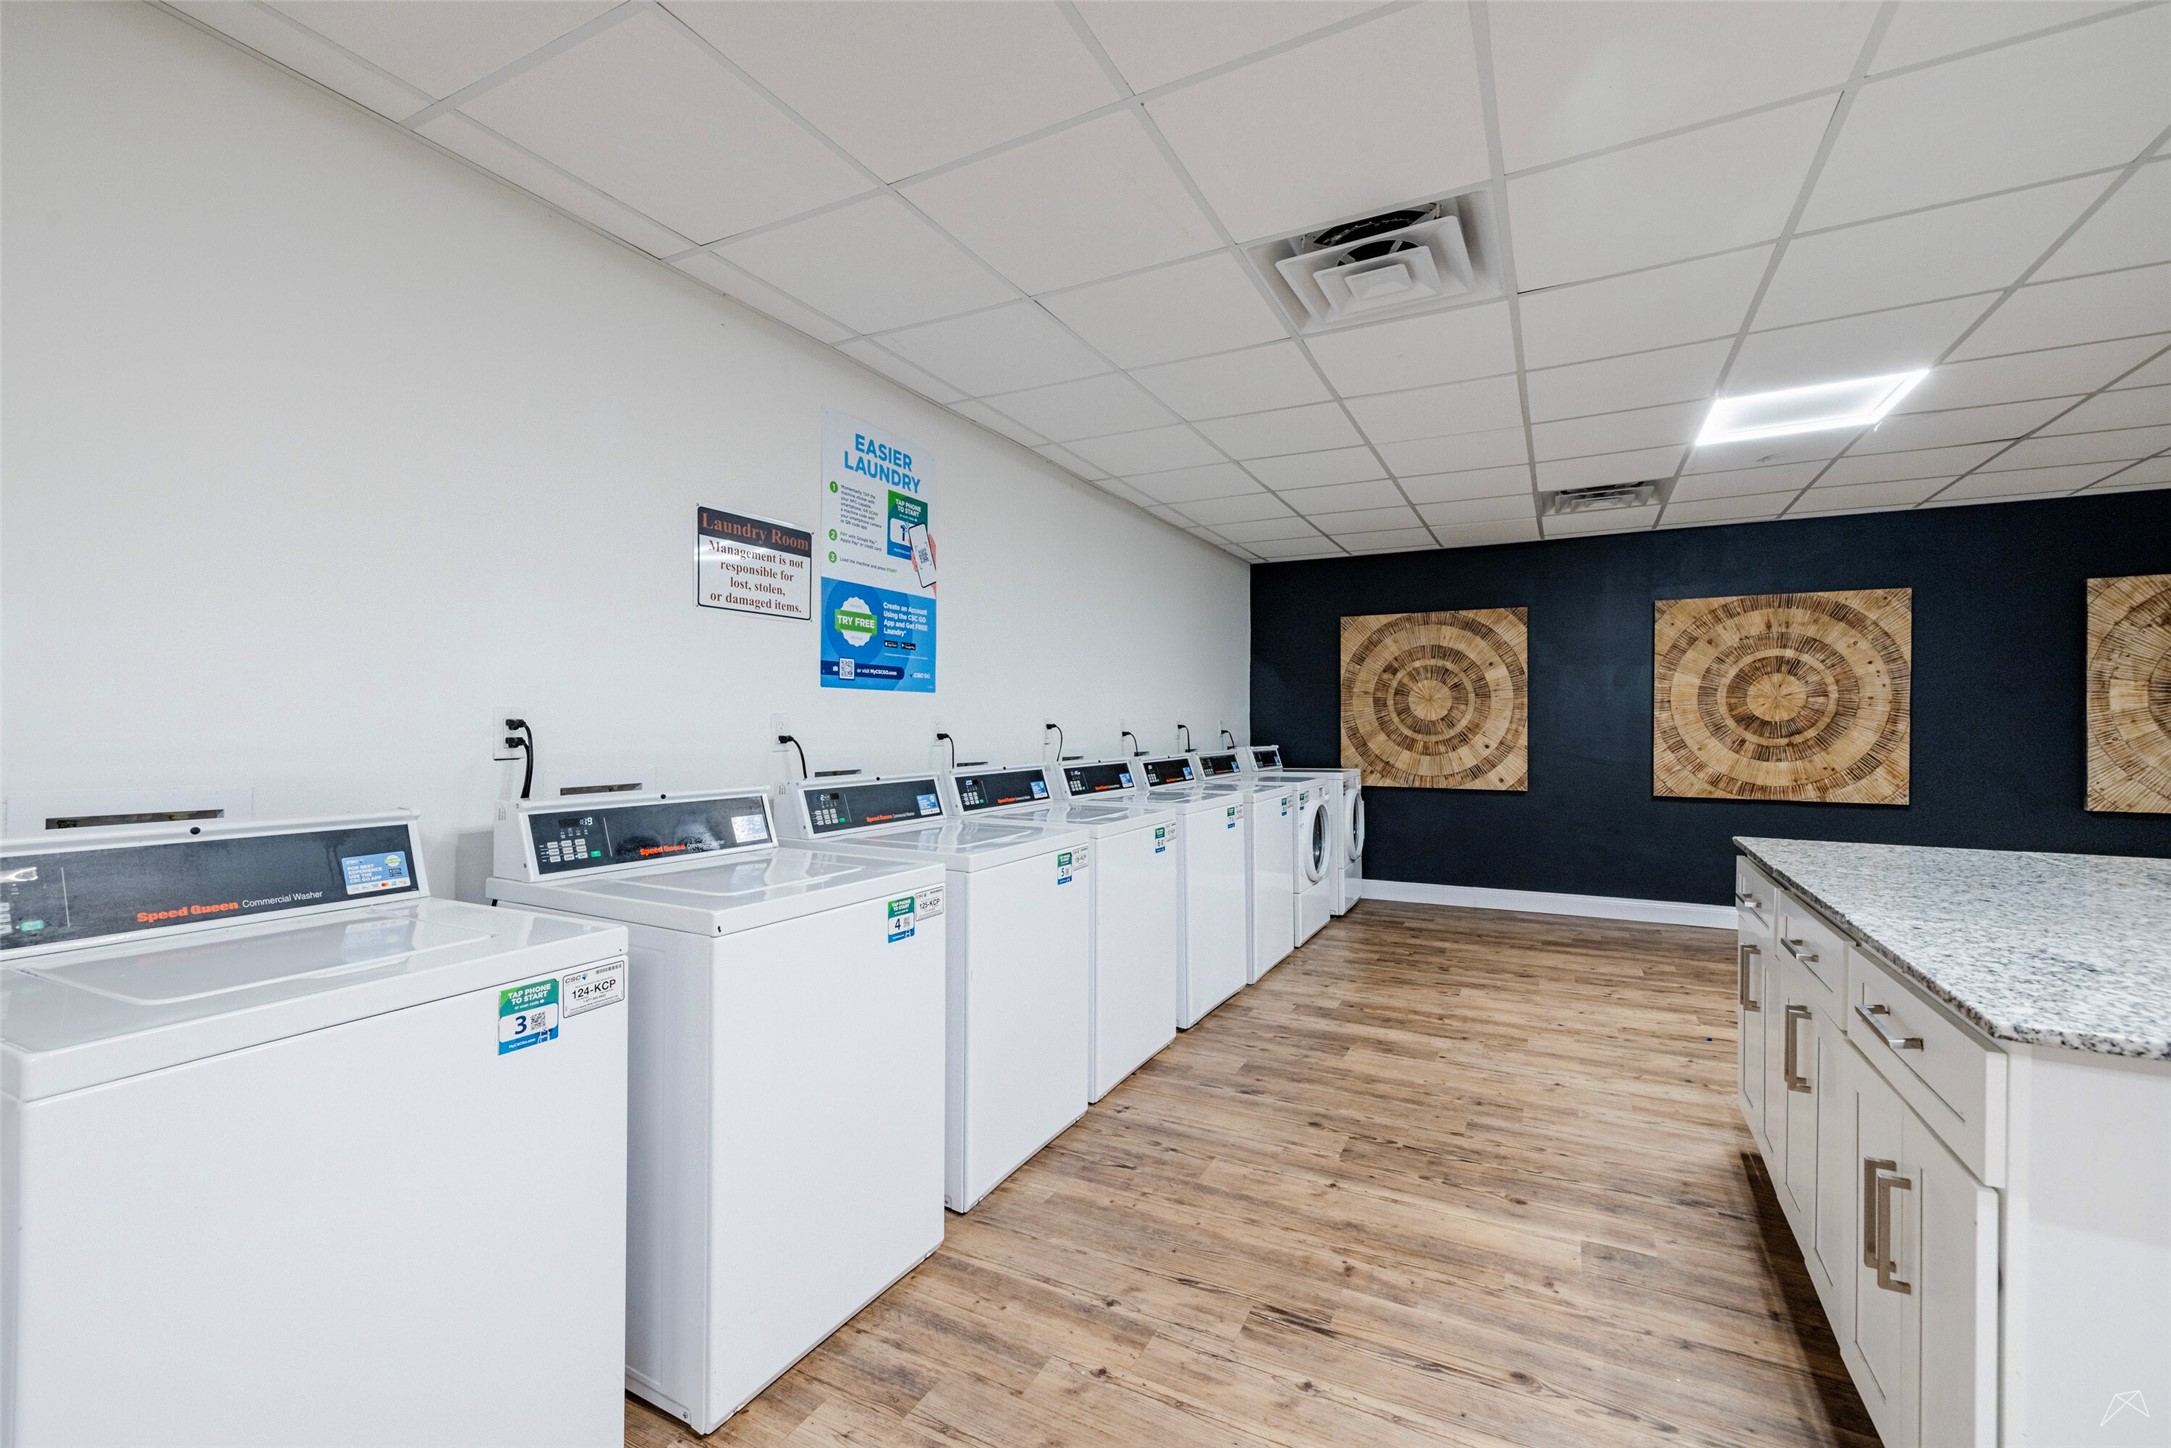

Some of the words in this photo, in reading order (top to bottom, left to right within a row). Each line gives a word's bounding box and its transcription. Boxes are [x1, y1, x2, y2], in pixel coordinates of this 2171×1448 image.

[855, 433, 912, 472] EASIER
[844, 450, 921, 494] LAUNDRY
[841, 490, 855, 499] machine
[856, 494, 867, 502] sticker
[844, 508, 858, 516] machine
[905, 508, 920, 517] START
[906, 501, 921, 512] PHONE
[849, 516, 869, 525] smartphone
[702, 512, 767, 544] Laundry
[771, 529, 809, 550] Room
[708, 539, 776, 563] Management
[779, 555, 786, 566] is
[789, 559, 804, 569] not
[720, 561, 778, 579] responsible
[780, 570, 794, 582] for
[730, 576, 752, 593] lost,
[754, 582, 786, 596] stolen,
[710, 592, 722, 601] or
[726, 592, 772, 610] damaged
[774, 599, 802, 613] items.
[883, 602, 900, 610] Create
[908, 606, 928, 616] Account
[836, 615, 853, 625] TRY
[855, 618, 875, 628] FREE
[884, 610, 898, 620] Using
[899, 612, 907, 620] the
[908, 614, 918, 622] CSC
[884, 619, 894, 628] App
[906, 622, 914, 630] Get
[640, 846, 663, 856] Speed
[664, 844, 686, 852] Queen
[136, 906, 189, 923] Speed
[190, 901, 239, 915] Queen
[242, 894, 292, 908] Commercial
[292, 890, 323, 901] Washer
[895, 918, 901, 930] 4
[565, 975, 581, 984] CSC
[508, 990, 523, 1000] TAP
[524, 983, 552, 995] PHONE
[572, 978, 617, 1000] 124-KCP
[511, 997, 522, 1005] TO
[523, 991, 548, 1002] START
[514, 1015, 527, 1035] 3
